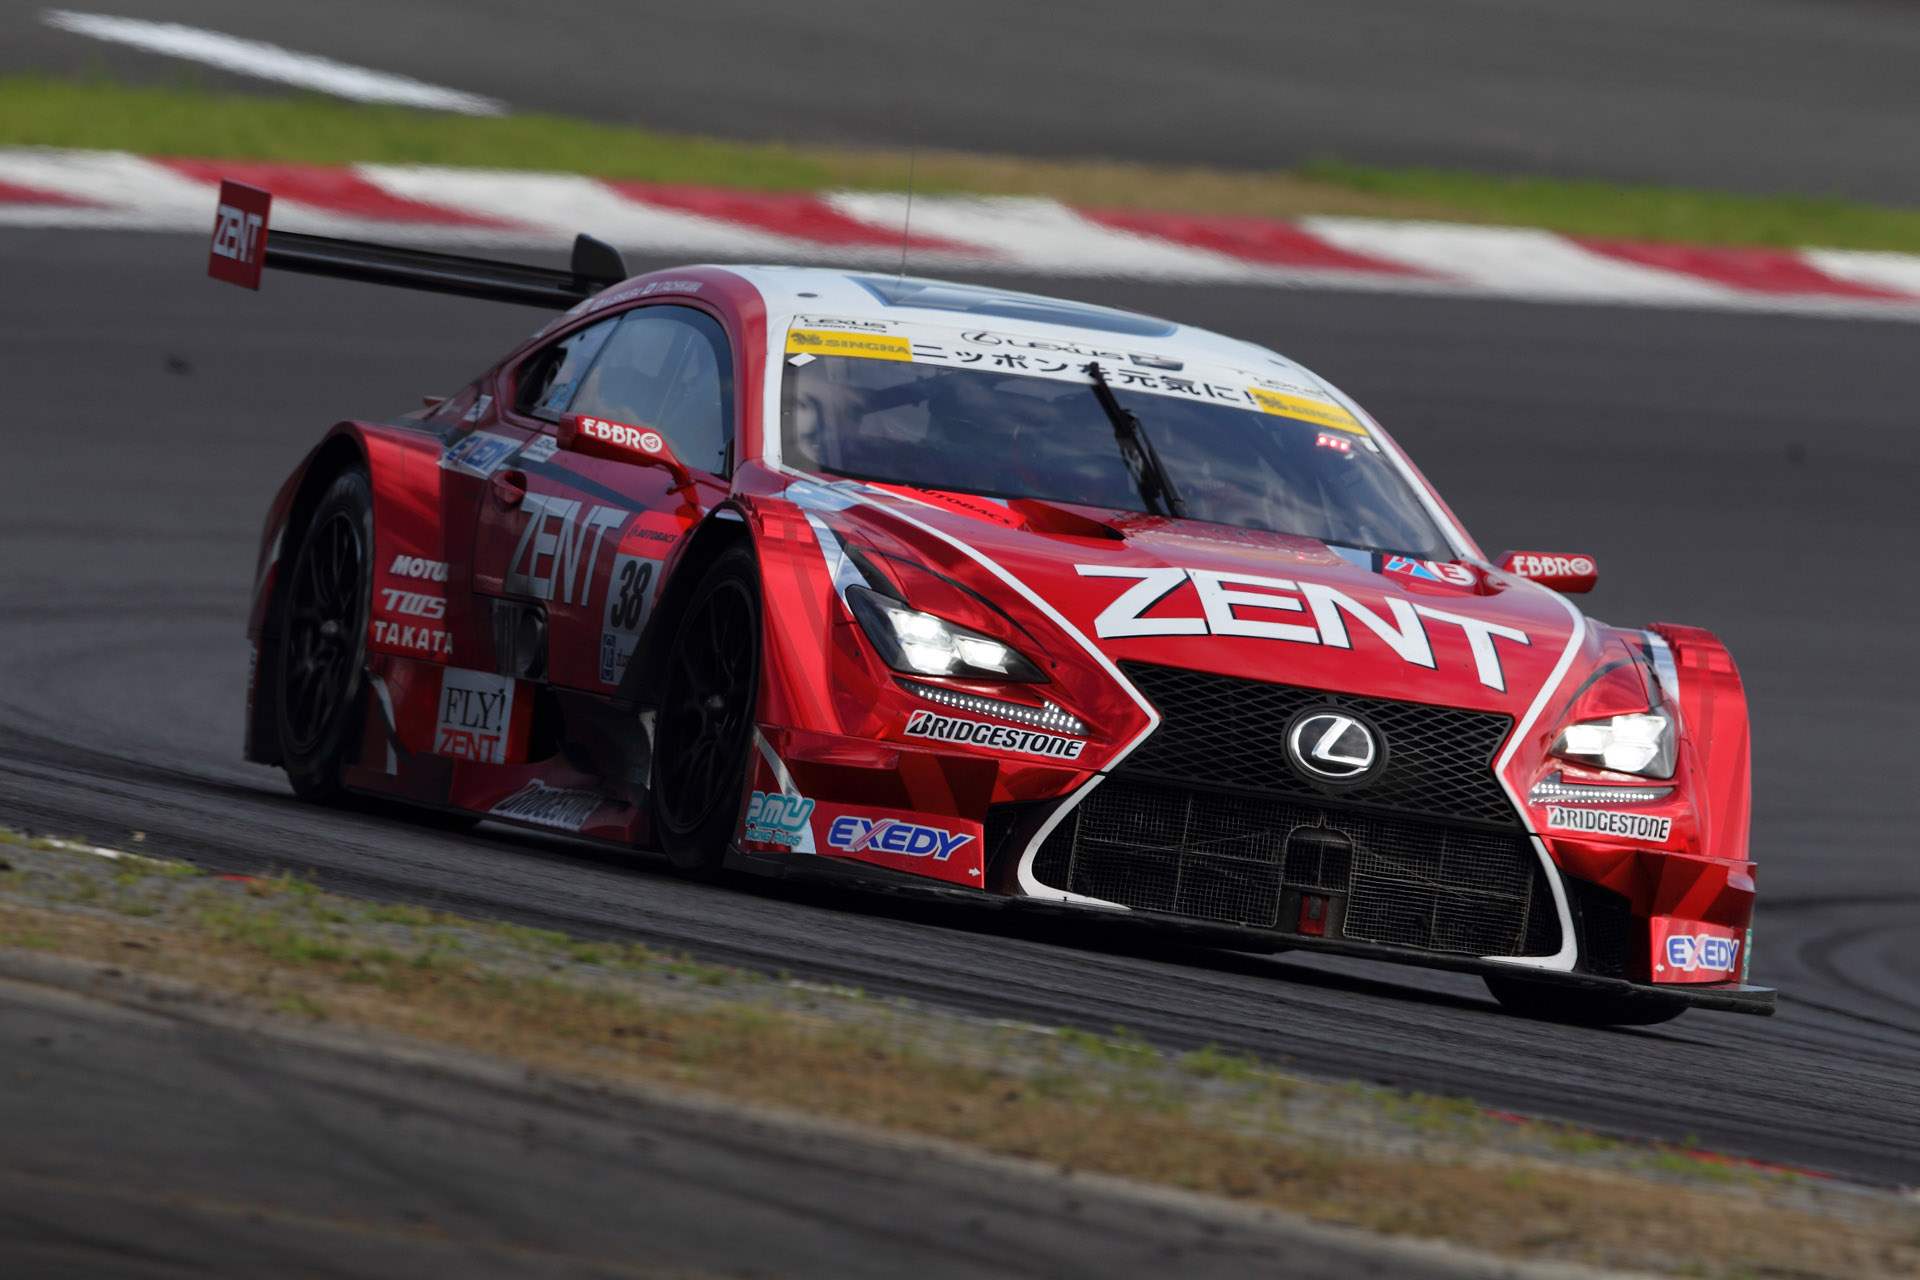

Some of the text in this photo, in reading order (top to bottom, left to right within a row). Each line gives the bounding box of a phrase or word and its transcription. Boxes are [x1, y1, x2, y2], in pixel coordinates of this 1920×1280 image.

[212, 204, 263, 264] ZENT
[803, 317, 887, 329] LEXUS
[825, 339, 910, 355] SINGHA
[1006, 339, 1124, 361] LEXUS
[582, 416, 663, 454] EBBRO
[505, 490, 630, 608] ZENT
[1511, 555, 1594, 578] EBBRO
[610, 559, 653, 631] 38
[374, 620, 453, 655] TAKATA
[1074, 563, 1532, 693] ZENT
[441, 686, 506, 733] FLY!
[438, 727, 501, 763] ZENT
[907, 712, 1083, 757] BRIDGESTONE
[745, 790, 816, 834] PMU
[1548, 808, 1670, 839] BRIDGESTONE
[771, 832, 803, 848] PADS
[829, 816, 975, 860] EXEDY
[1668, 934, 1739, 971] EXEDY
